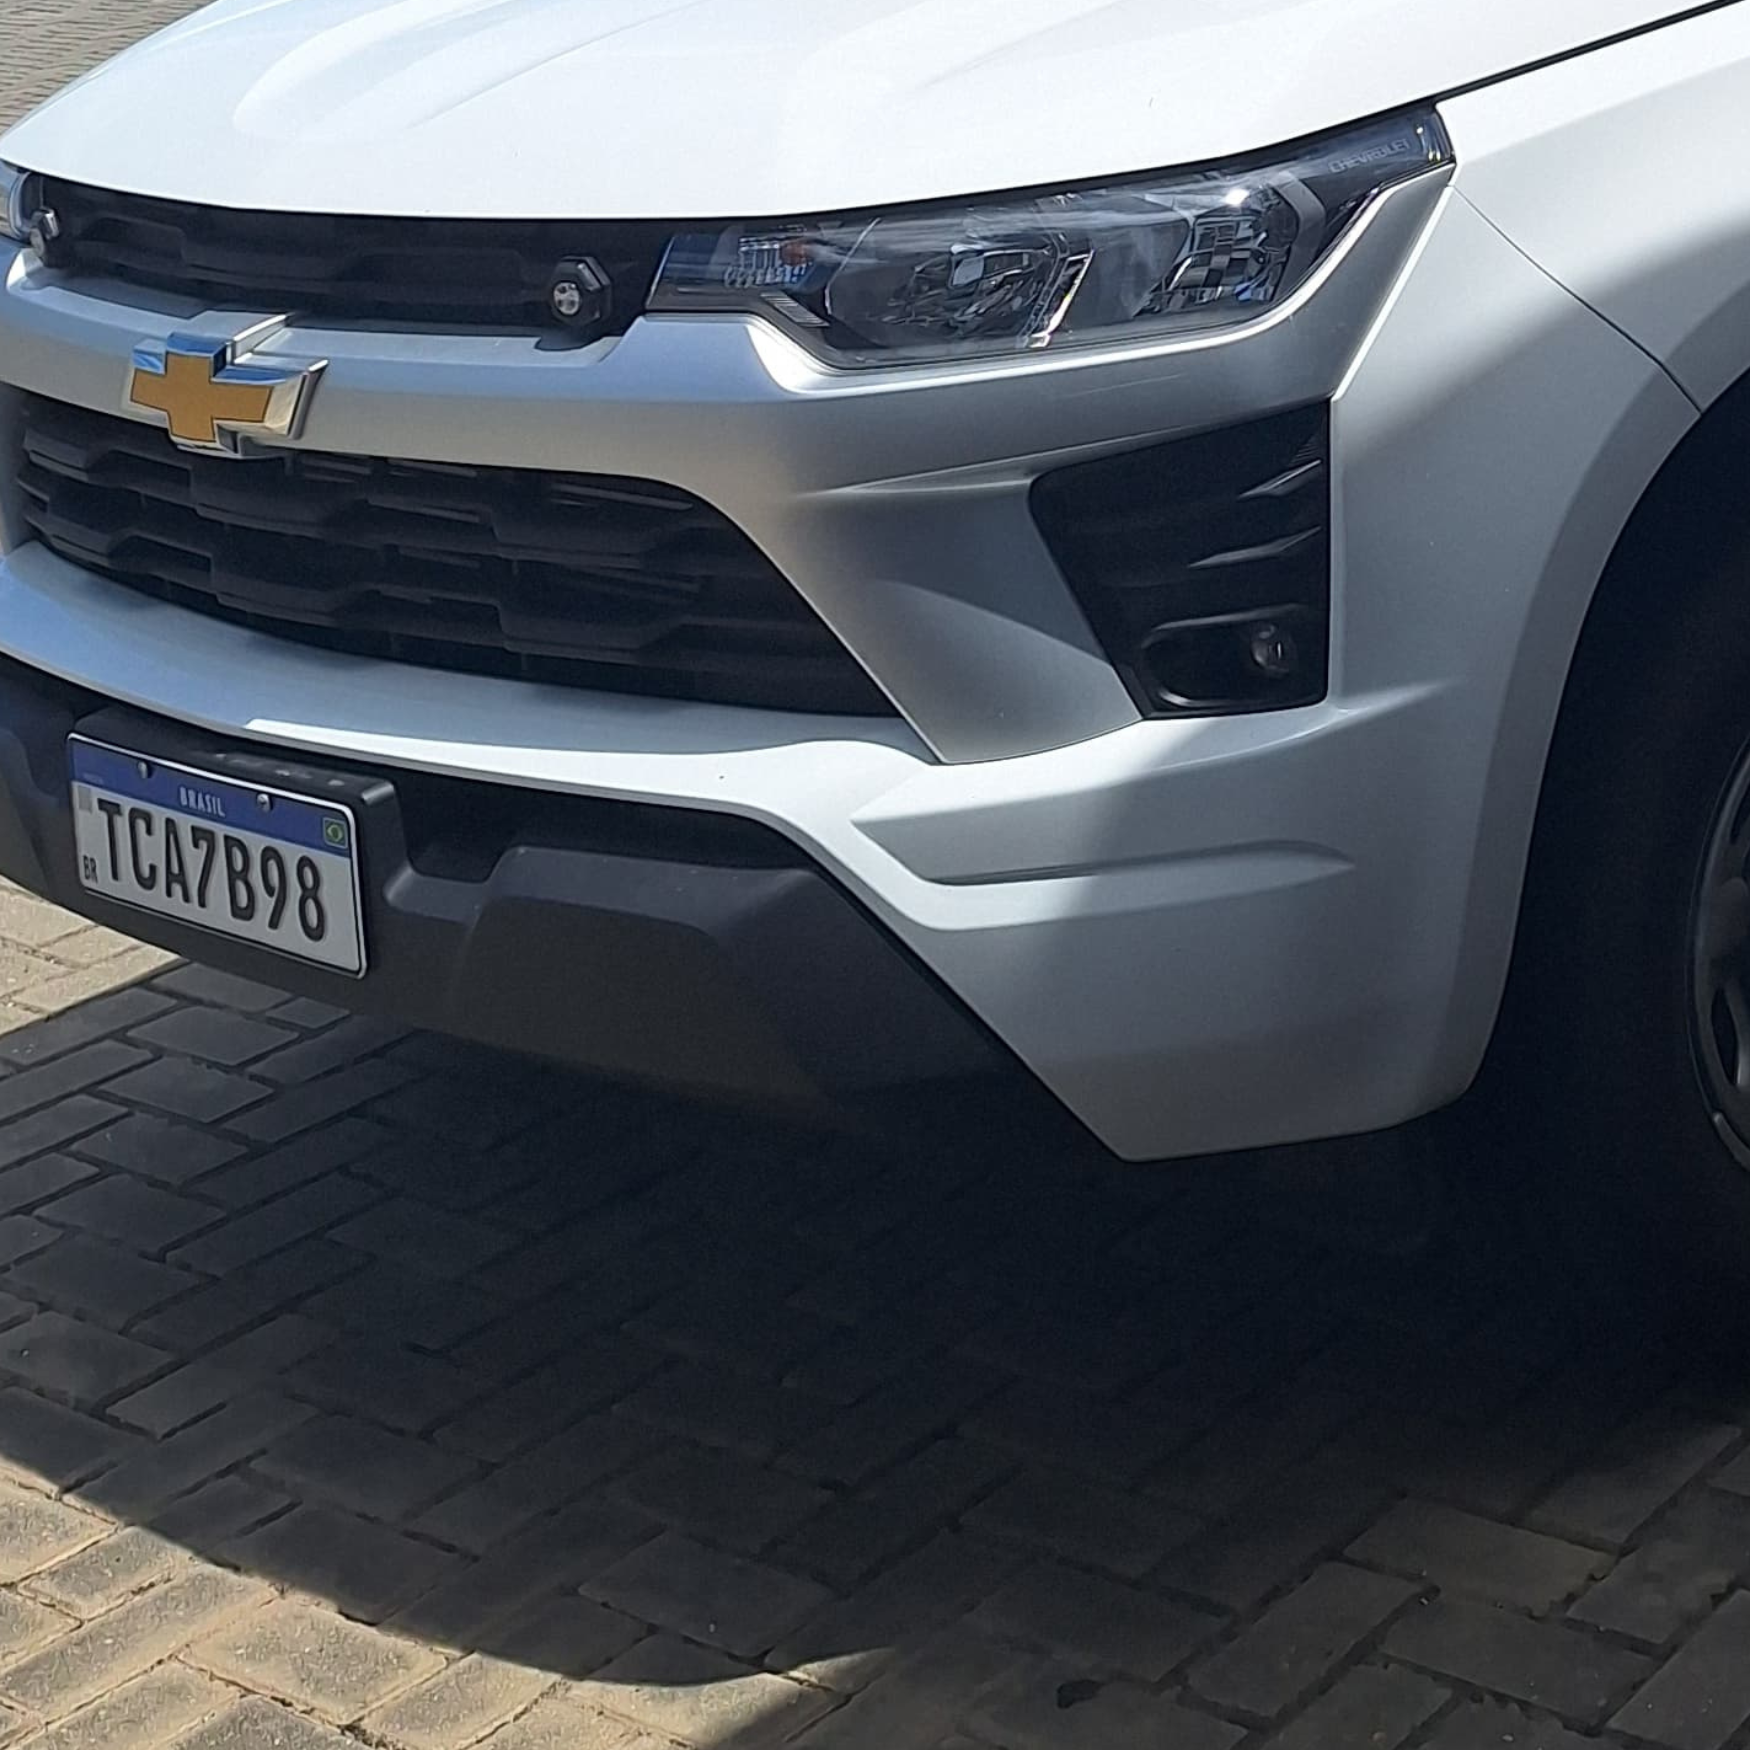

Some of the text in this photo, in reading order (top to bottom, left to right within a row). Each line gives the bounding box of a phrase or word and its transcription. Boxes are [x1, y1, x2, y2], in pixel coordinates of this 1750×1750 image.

[179, 786, 226, 818] BRASIL
[83, 854, 98, 884] BR
[97, 797, 326, 943] TCA7B98
